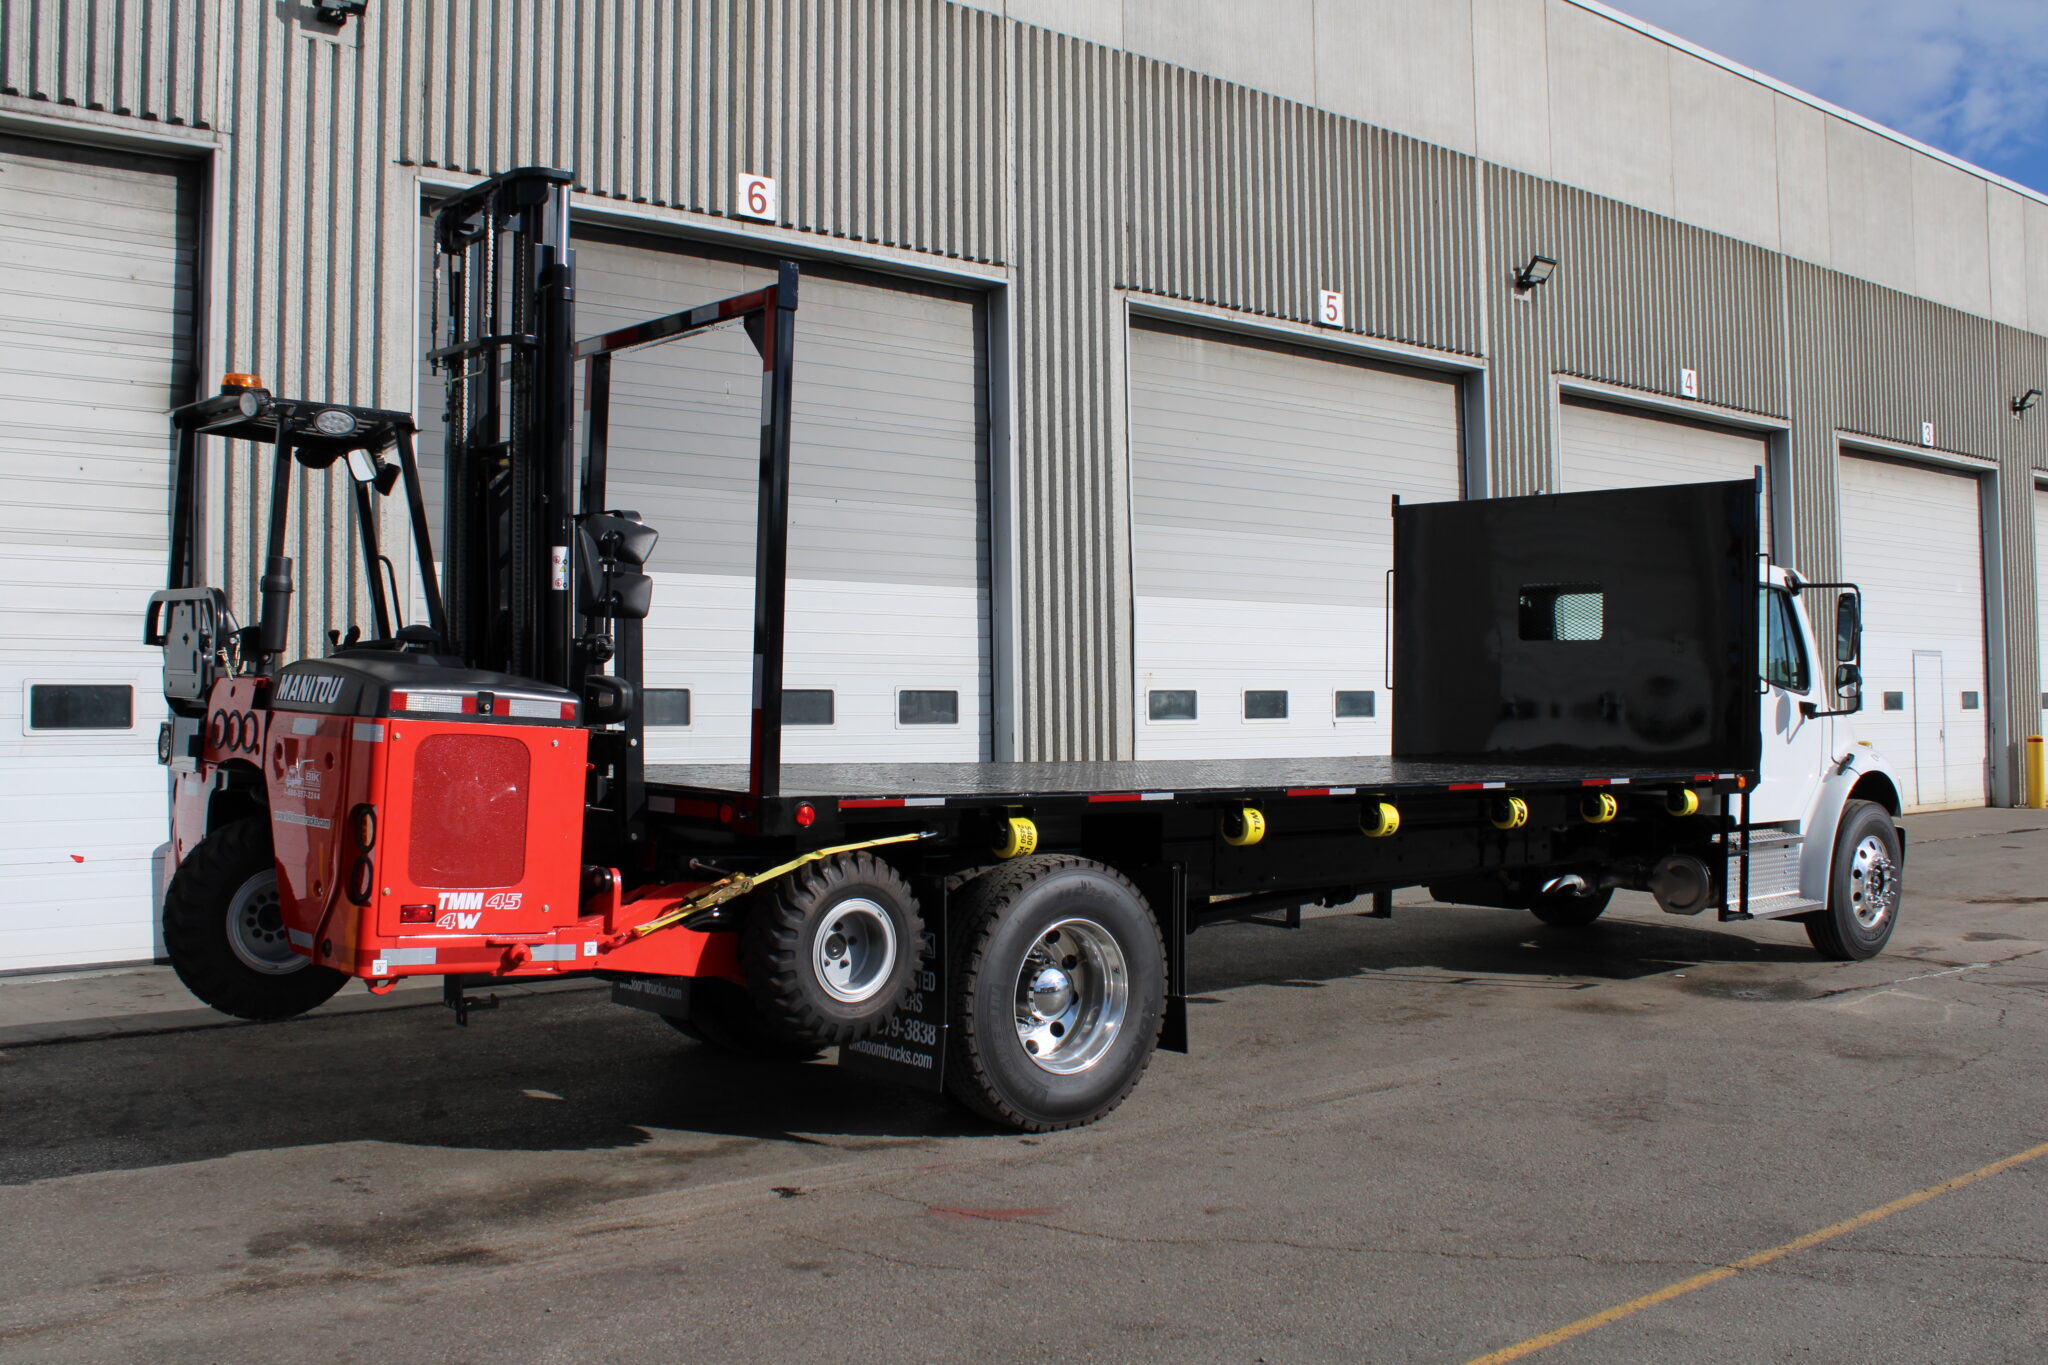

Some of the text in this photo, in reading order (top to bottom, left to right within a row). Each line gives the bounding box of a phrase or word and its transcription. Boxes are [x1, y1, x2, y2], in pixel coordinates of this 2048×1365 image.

[748, 181, 767, 214] 6
[1326, 295, 1338, 321] 5
[1685, 373, 1693, 394] 4
[1925, 425, 1931, 443] 3
[276, 674, 344, 703] MANITOU
[438, 892, 523, 910] TMM 45
[436, 912, 482, 930] 4W
